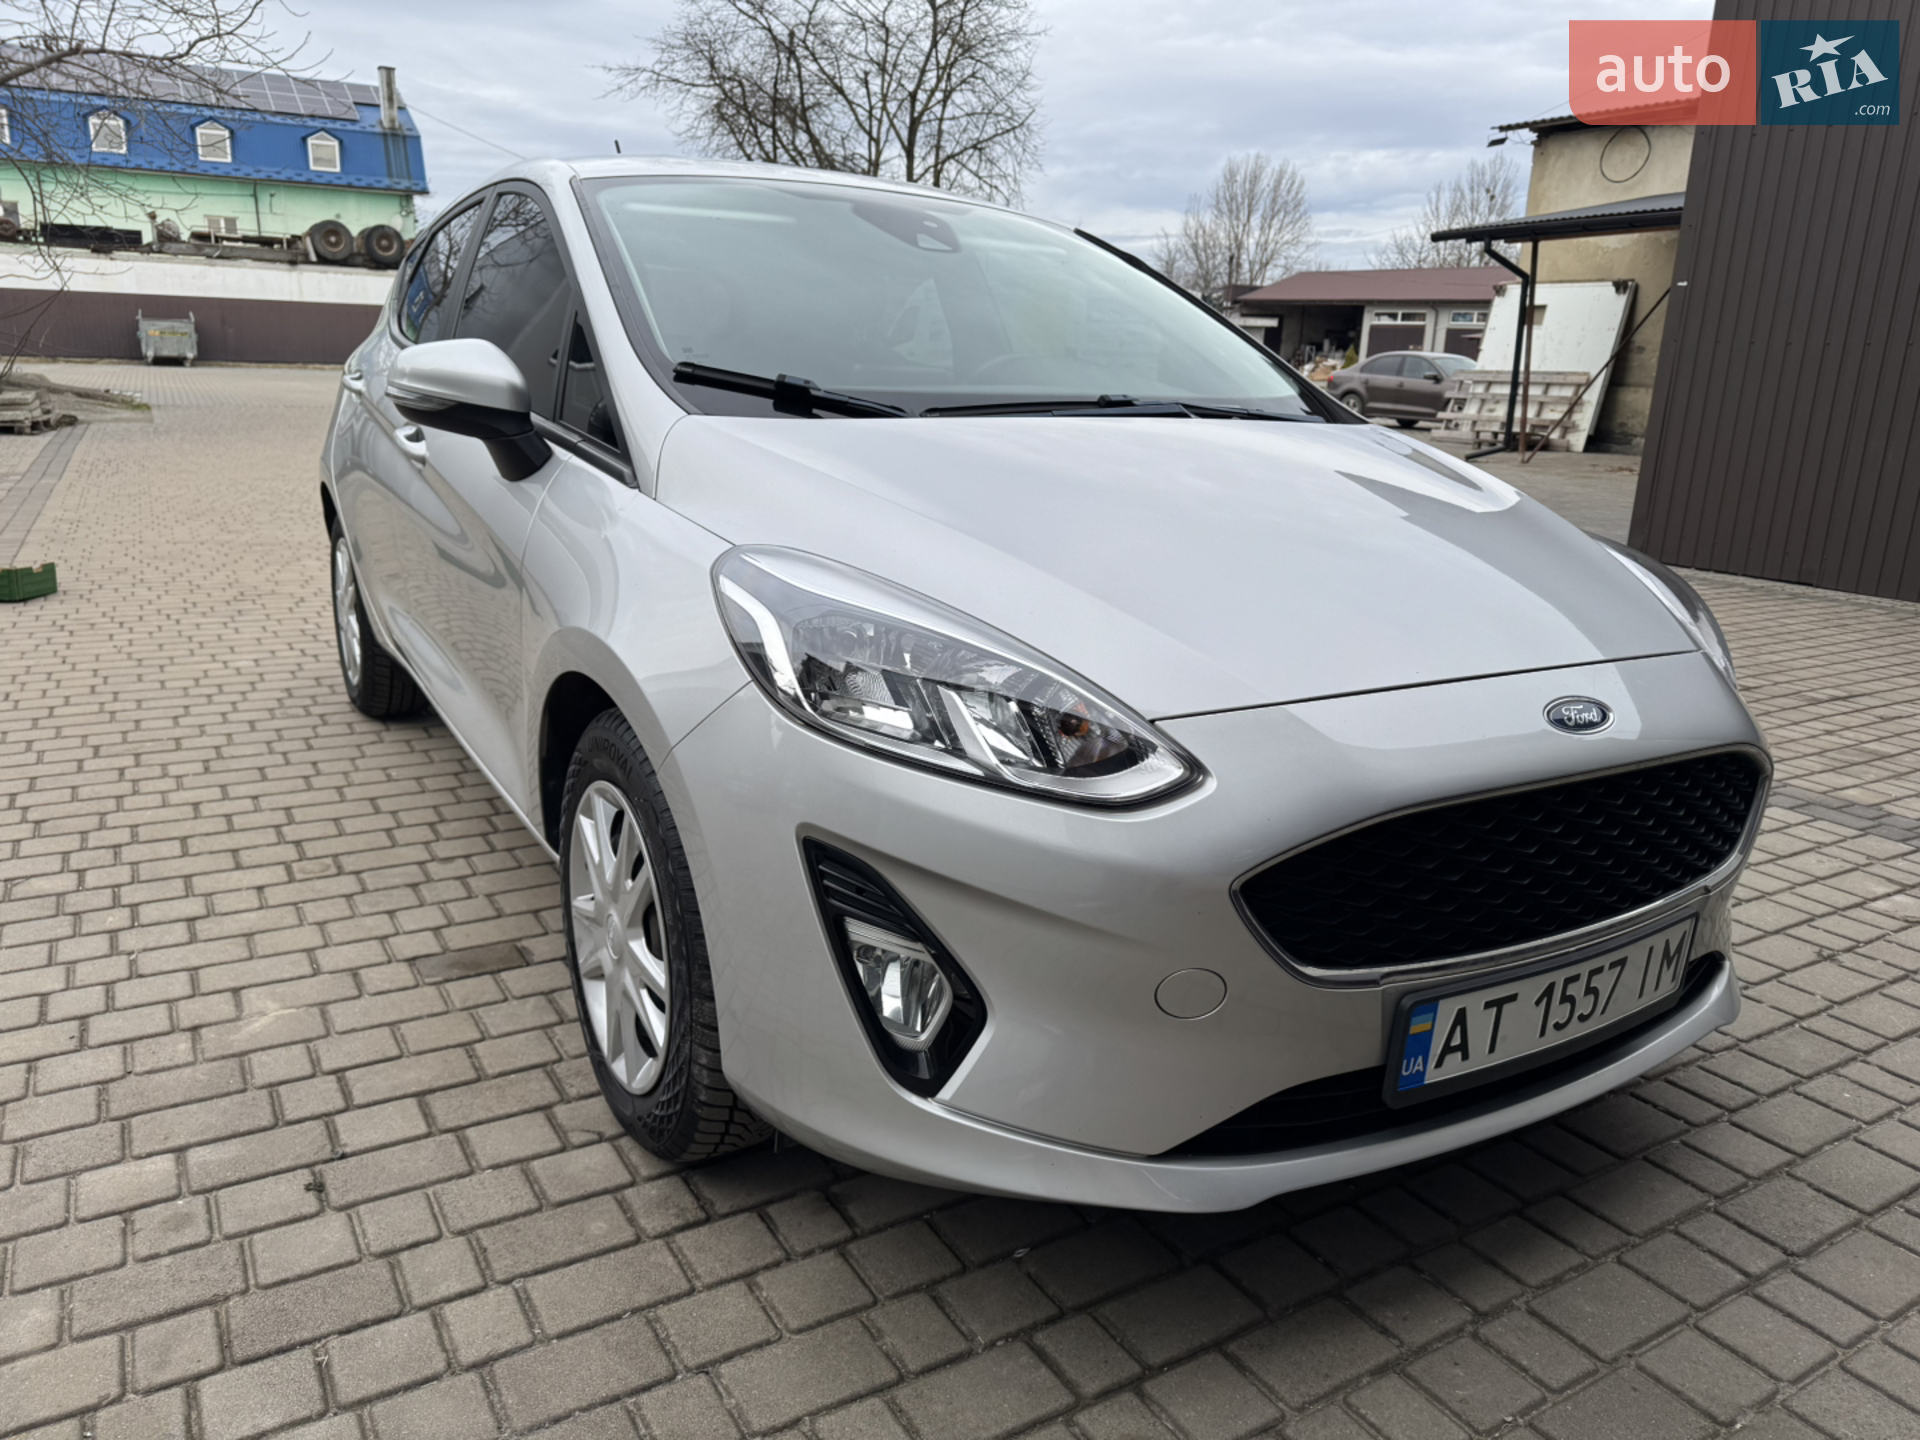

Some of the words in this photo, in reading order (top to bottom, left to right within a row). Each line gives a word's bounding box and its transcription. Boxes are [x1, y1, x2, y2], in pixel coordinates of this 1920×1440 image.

[1562, 705, 1601, 727] Ford
[587, 736, 633, 780] UNIROYAL
[1433, 993, 1518, 1070] AT
[1534, 956, 1629, 1039] 1557
[1638, 930, 1687, 999] IM
[1401, 1056, 1424, 1076] UA
